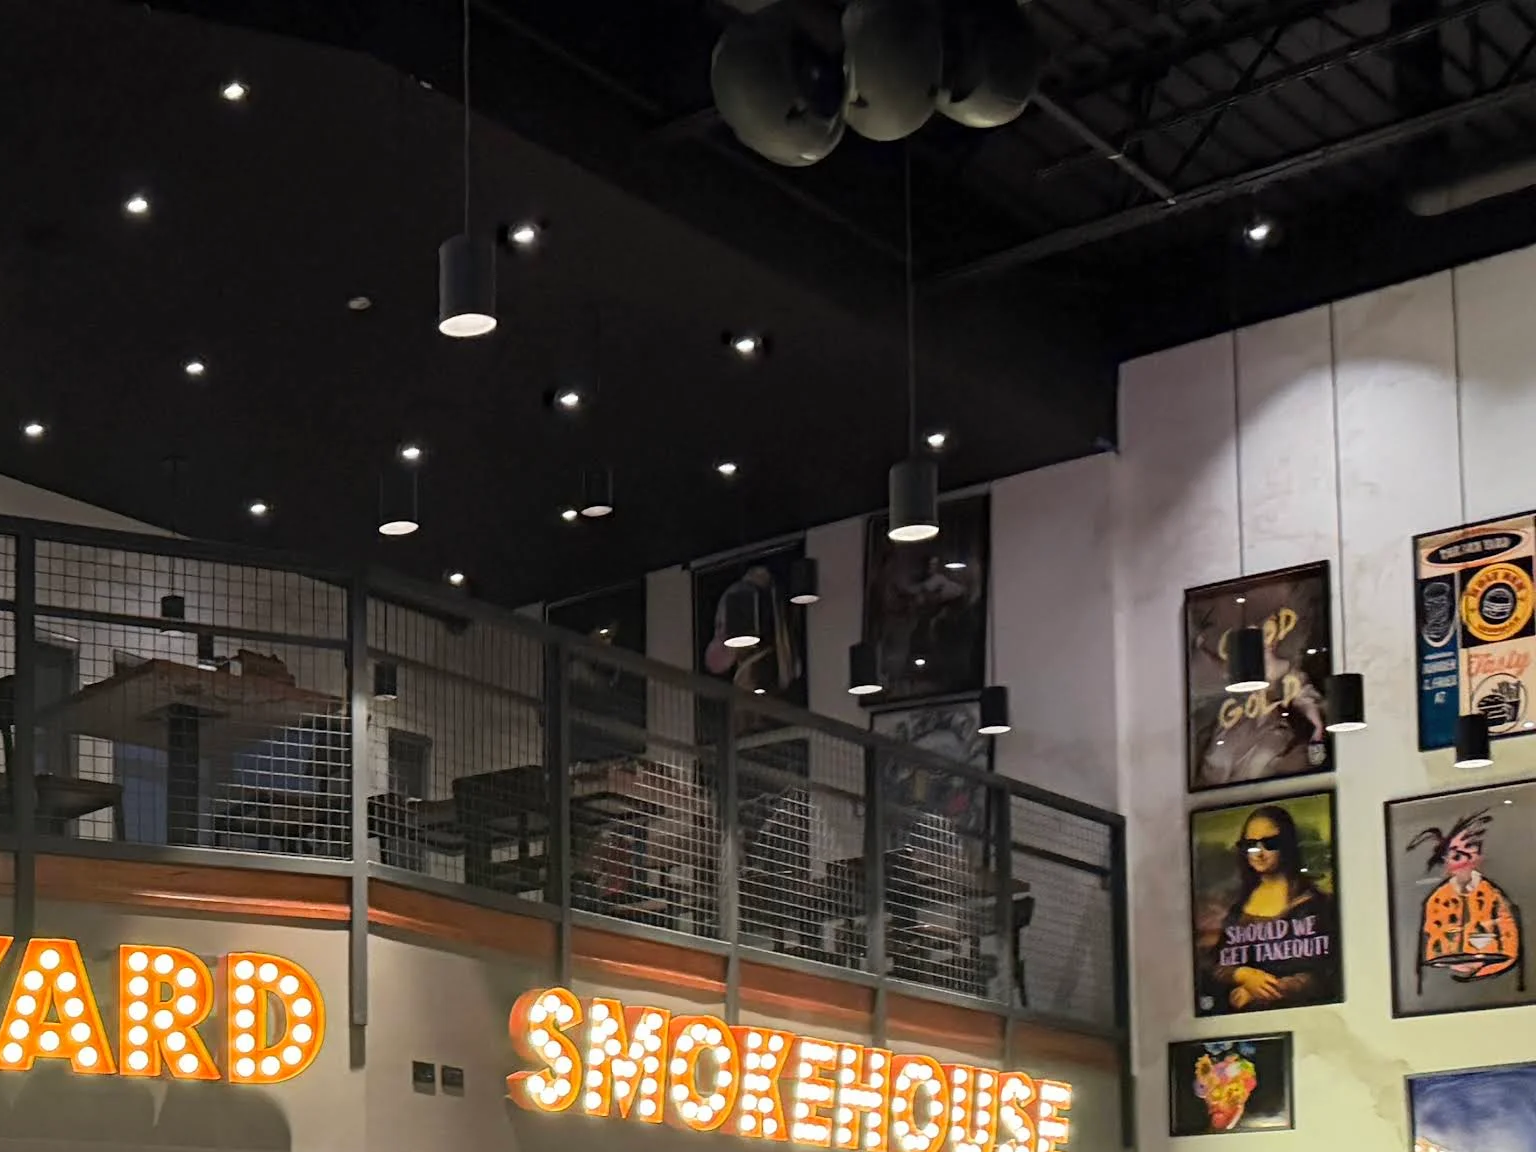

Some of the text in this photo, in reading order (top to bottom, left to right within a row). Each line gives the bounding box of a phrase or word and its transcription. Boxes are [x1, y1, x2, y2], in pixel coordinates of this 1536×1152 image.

[1219, 675, 1302, 729] GOLD
[1226, 915, 1316, 945] SHOULD WE
[1220, 935, 1329, 966] GET TAKEOUT!
